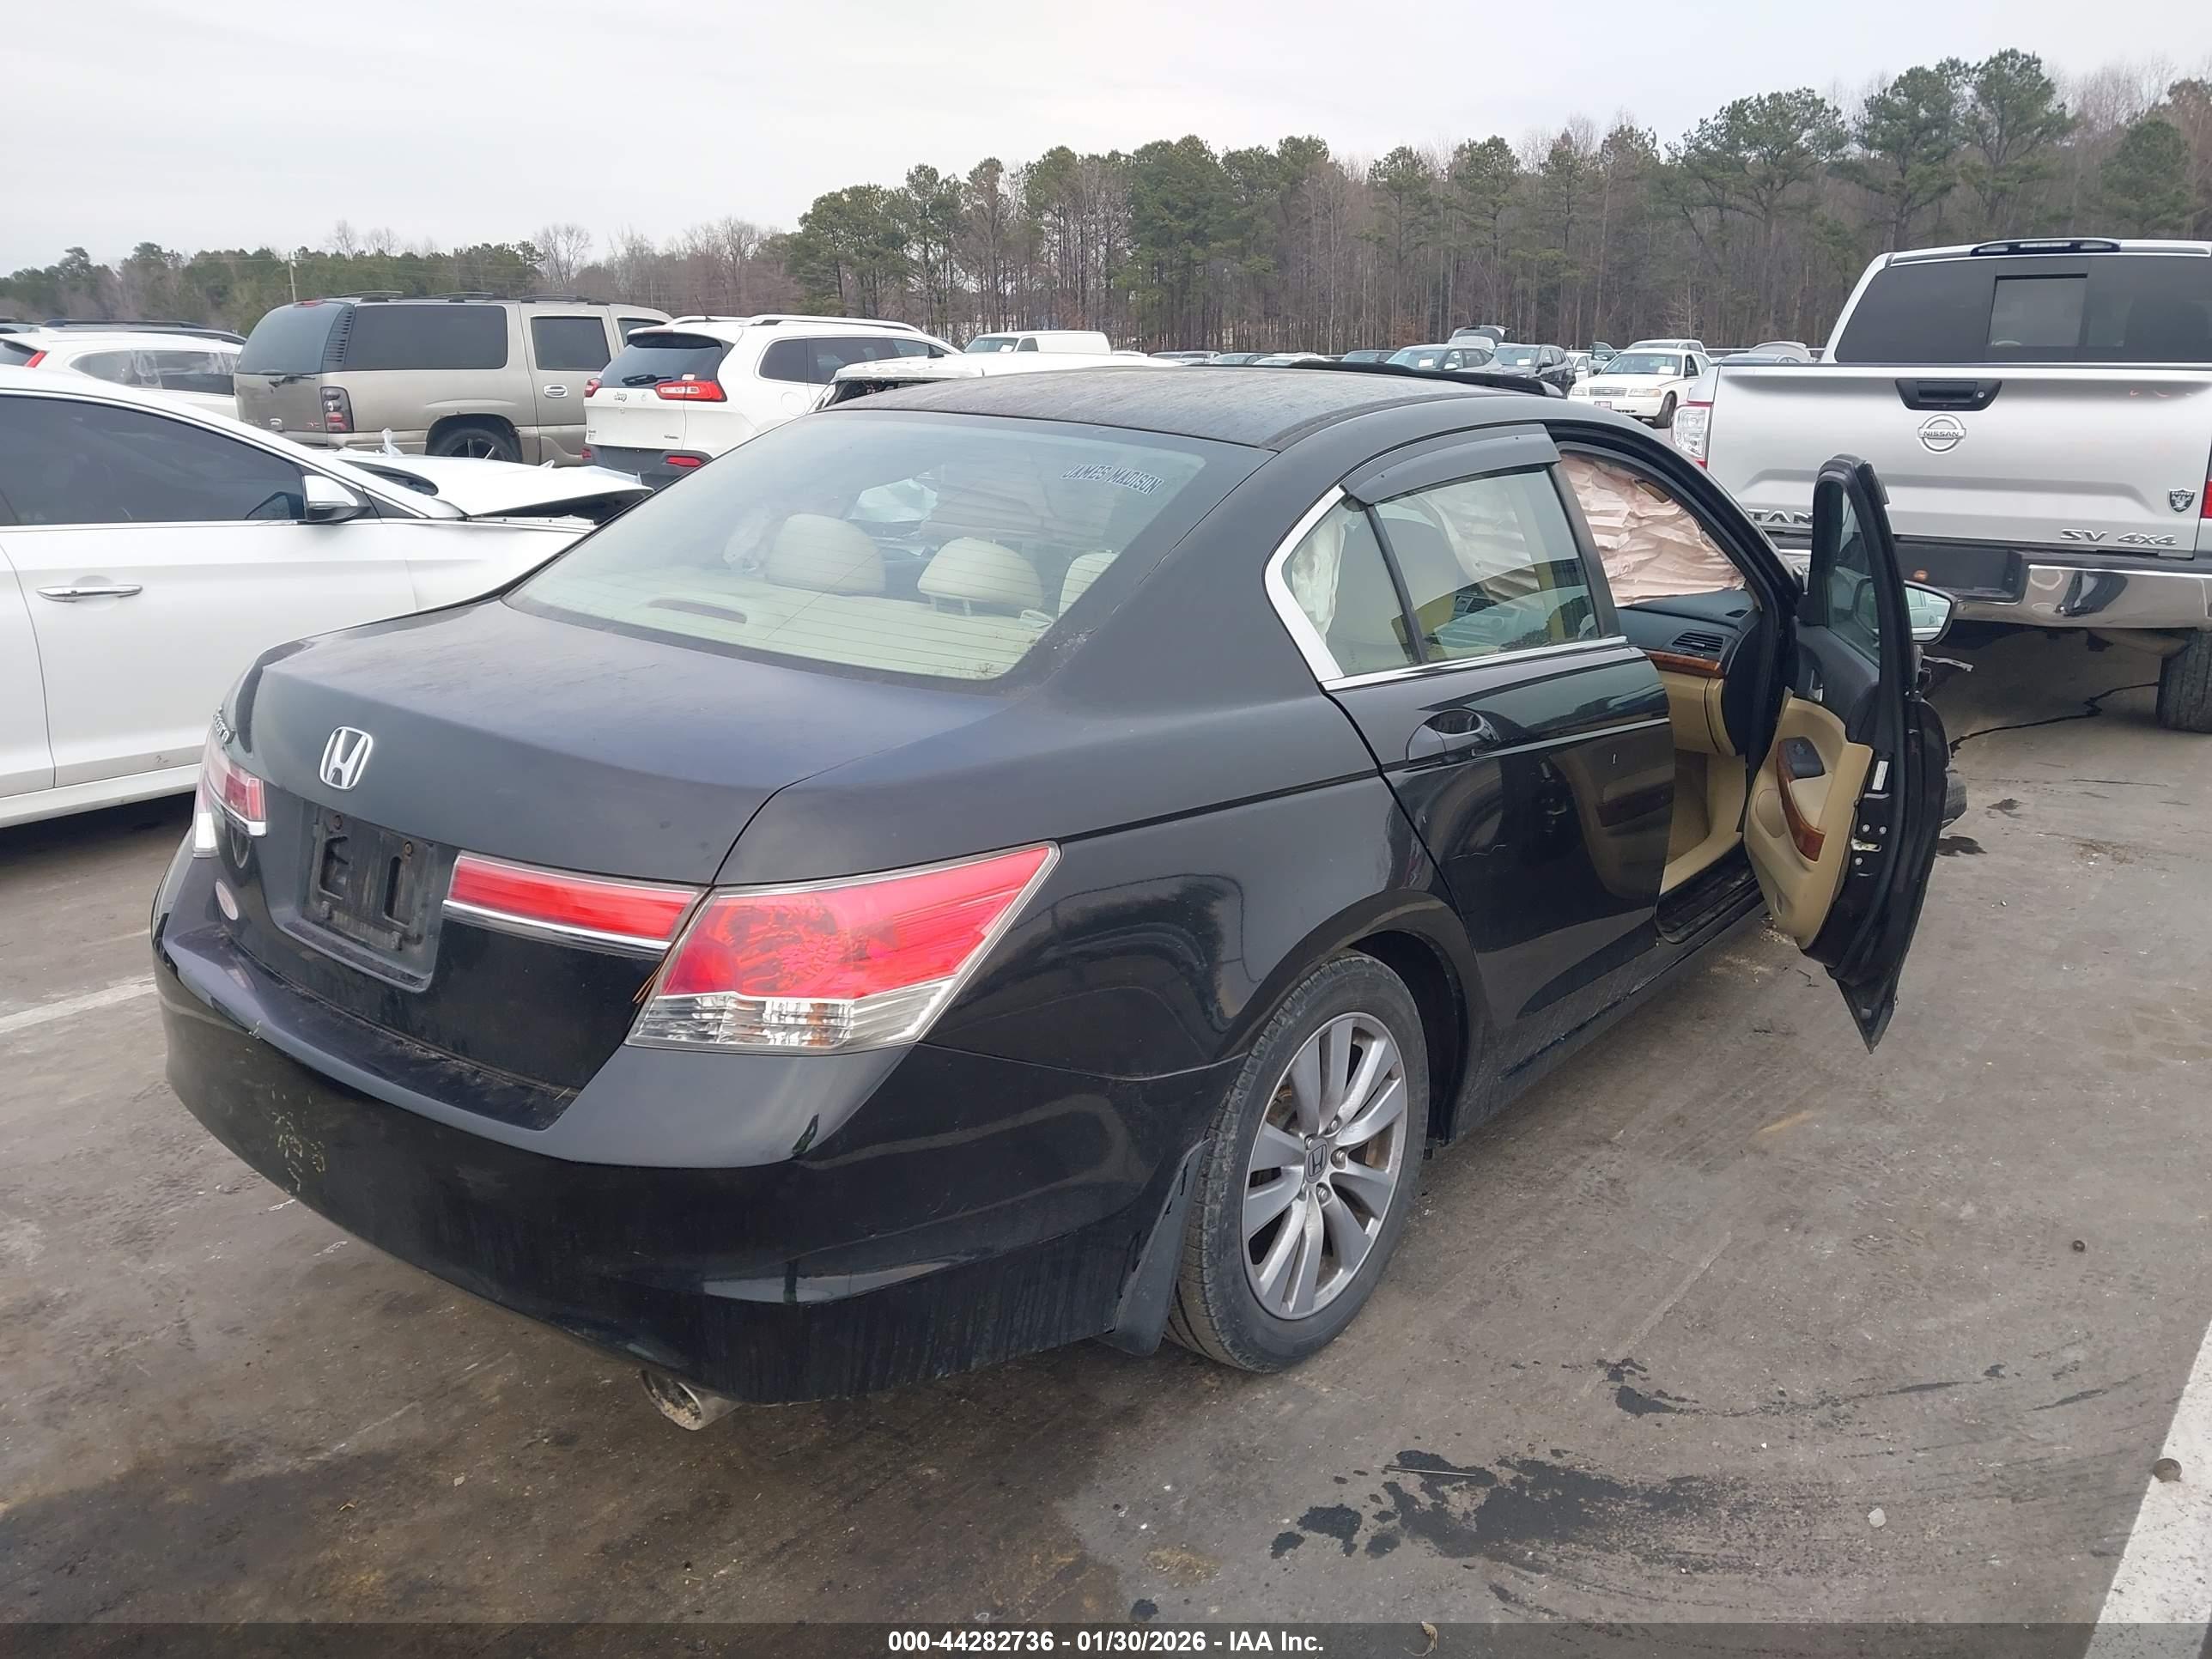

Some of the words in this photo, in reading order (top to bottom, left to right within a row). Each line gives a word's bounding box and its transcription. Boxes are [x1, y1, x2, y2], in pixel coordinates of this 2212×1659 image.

[1060, 464, 1114, 480] JAMES
[1105, 466, 1164, 495] MADISON
[1747, 508, 1814, 525] TAN
[2060, 528, 2109, 543] SV
